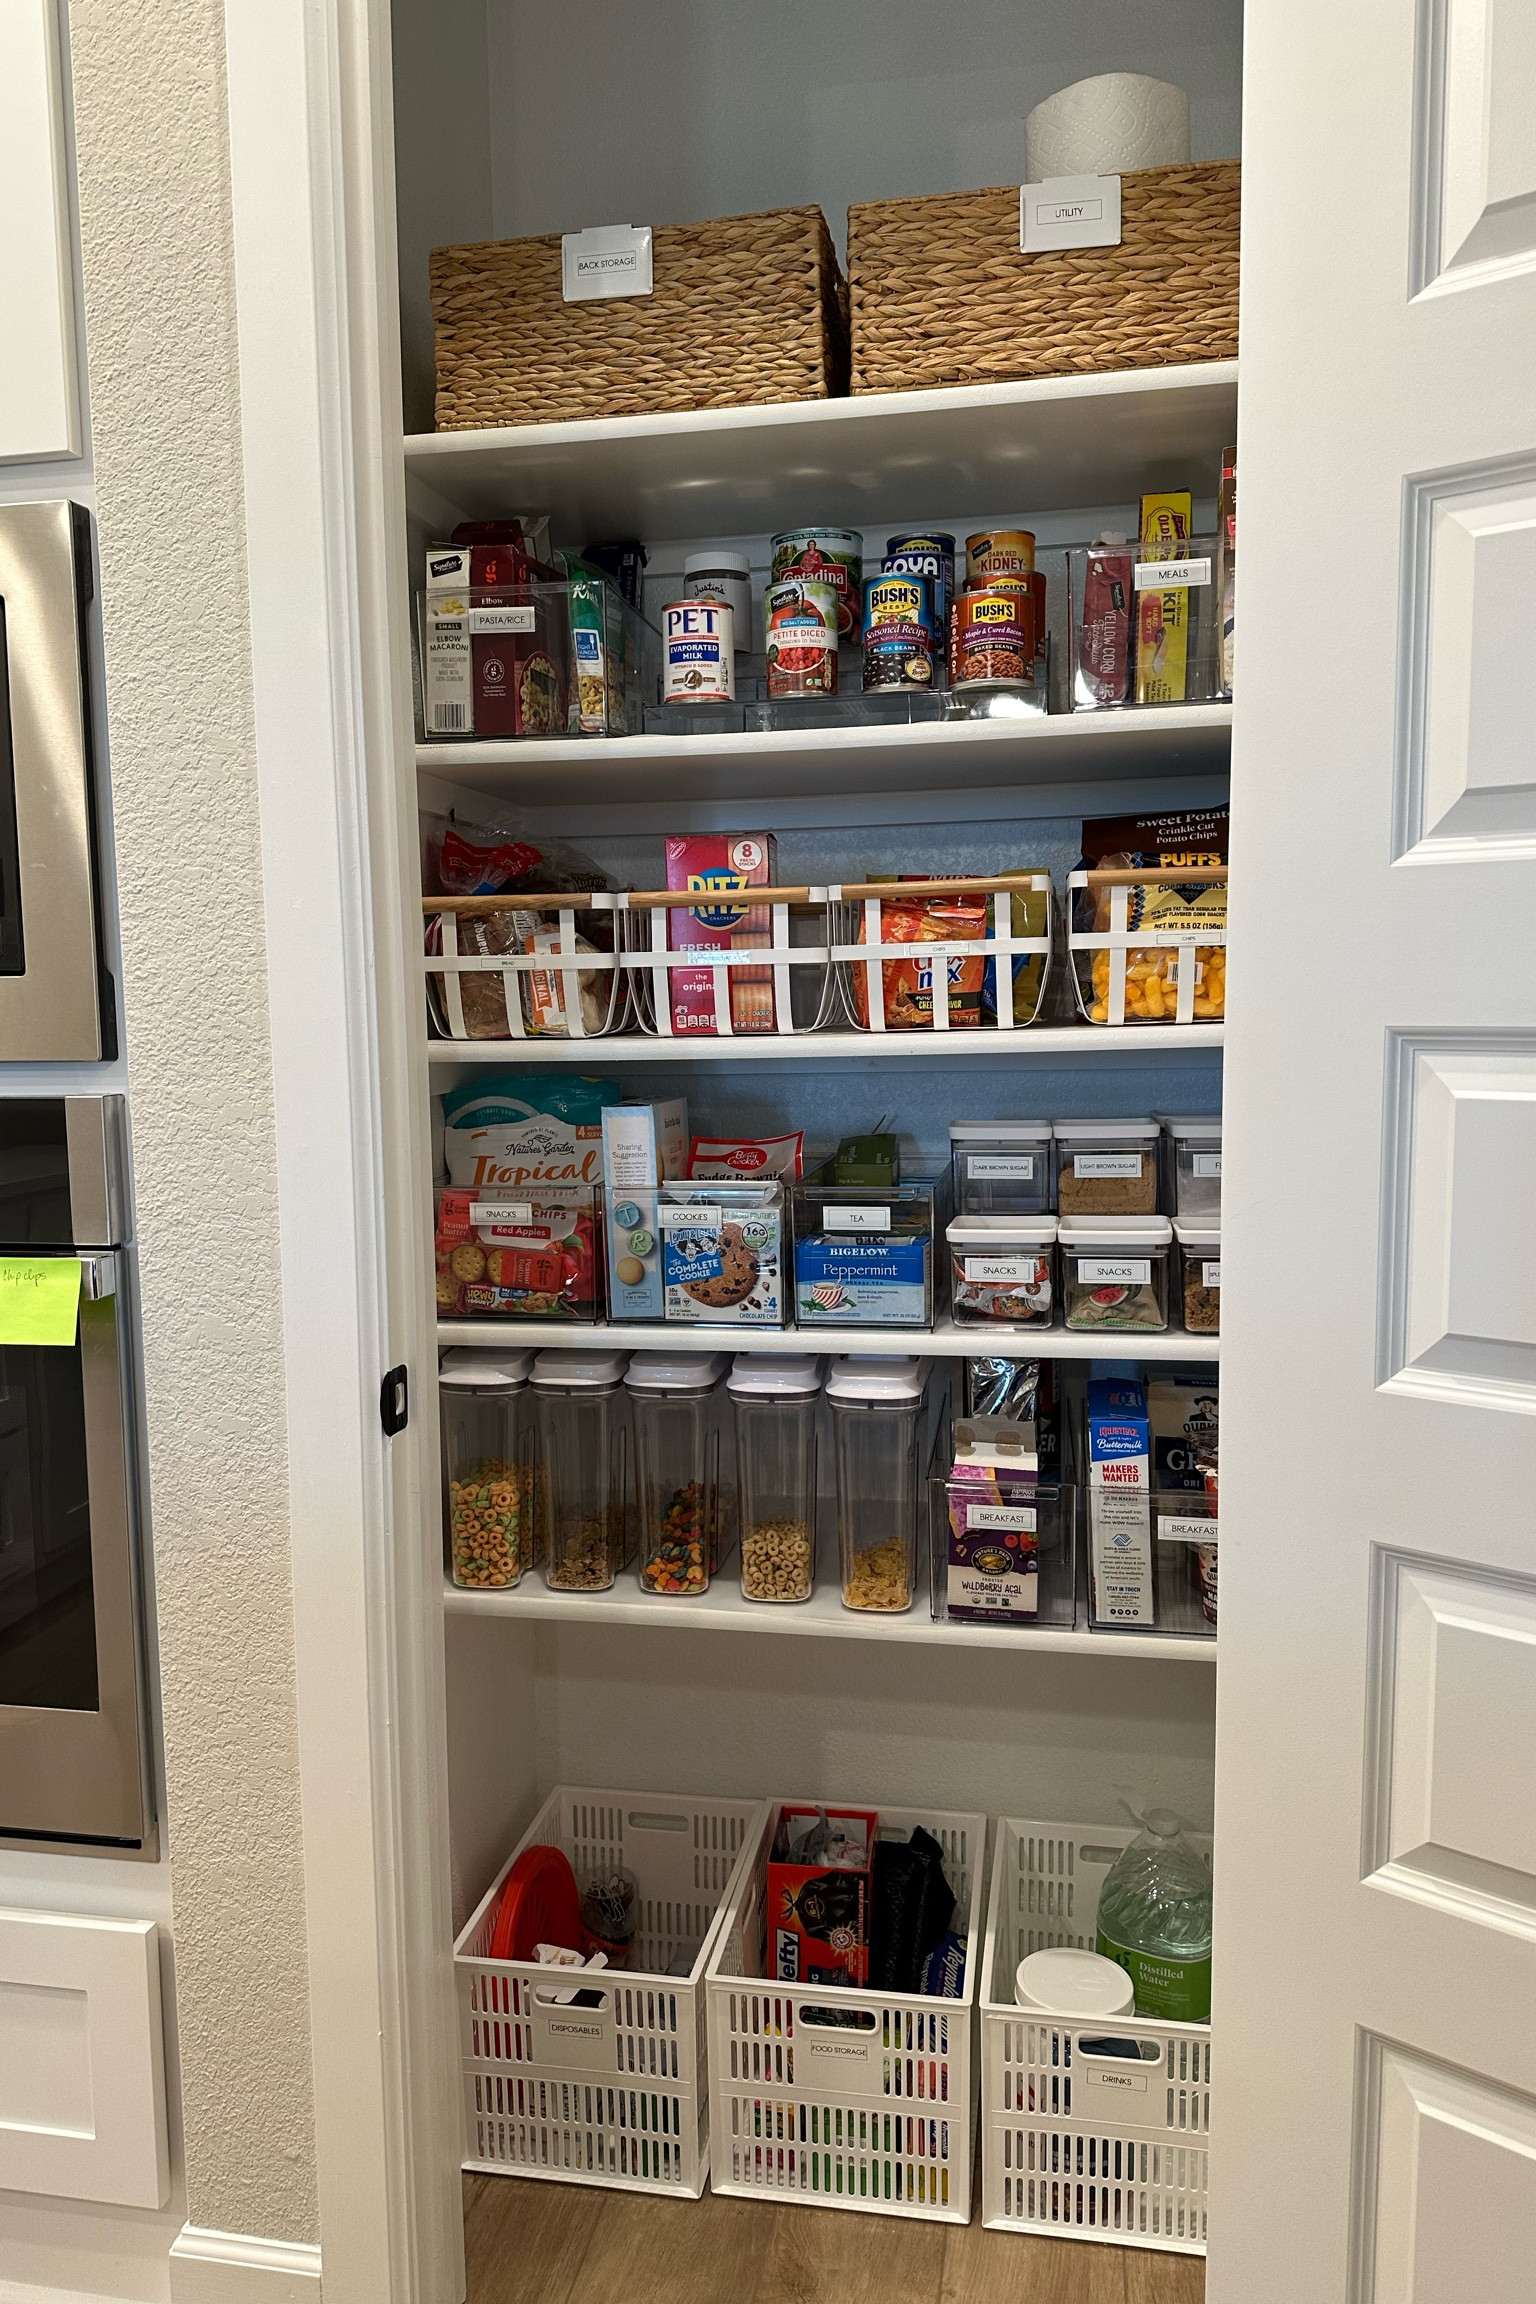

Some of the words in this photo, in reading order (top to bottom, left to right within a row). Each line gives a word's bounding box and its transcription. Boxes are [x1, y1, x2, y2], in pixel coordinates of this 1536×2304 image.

[1055, 207, 1084, 218] UTILITY
[579, 261, 600, 270] BACK
[600, 257, 635, 268] STORAGE
[884, 557, 938, 576] GOYA
[981, 558, 1024, 572] KIDNEY
[1158, 569, 1189, 579] MEALS
[695, 582, 726, 596] Justin's
[481, 597, 504, 605] Elbow
[871, 587, 919, 609] BUSH'S
[975, 603, 1013, 620] BUSH'S
[1162, 592, 1177, 627] KIT
[479, 616, 526, 626] PASTA/RICE
[668, 608, 718, 637] PET
[1151, 607, 1159, 628] HARD
[866, 624, 900, 641] Seasoned
[901, 624, 927, 637] Recipe
[964, 628, 982, 640] Maple
[1006, 627, 1023, 637] Bacon
[1103, 610, 1117, 646] YELLOW
[436, 635, 462, 643] ELBOW
[773, 630, 799, 640] PETITE
[801, 629, 826, 638] DICED
[429, 643, 469, 652] MACARONI
[670, 644, 718, 654] EVAPORATED
[873, 646, 893, 654] BLACK
[974, 644, 993, 652] BAKED
[994, 643, 1014, 651] BEANS
[682, 651, 703, 660] MILK
[1100, 647, 1116, 675] CORN
[1103, 682, 1115, 698] 12
[1158, 825, 1196, 836] Crinkle
[1197, 822, 1216, 830] Cut
[1156, 835, 1188, 844] Potato
[1189, 830, 1218, 841] Chips
[741, 843, 753, 858] 8
[1160, 852, 1222, 868] PUFFS
[687, 875, 750, 918] RITZ
[680, 943, 721, 952] FRESH
[919, 967, 963, 991] mx
[533, 969, 550, 1001] IGINAL
[682, 981, 715, 993] origin
[577, 1129, 586, 1138] 4
[543, 1142, 576, 1157] Garden
[616, 1143, 643, 1152] Sharing
[612, 1151, 648, 1160] Suggestion
[734, 1150, 760, 1160] Betty
[727, 1157, 762, 1166] Crocker
[1116, 1161, 1137, 1169] SUGAR
[470, 1149, 601, 1186] Tropical
[486, 1210, 517, 1219] SNACKS
[532, 1209, 567, 1220] CHIPS
[672, 1212, 708, 1221] COOKIES
[849, 1214, 865, 1222] TEA
[443, 1220, 469, 1230] Peanut
[496, 1225, 516, 1235] Red
[518, 1226, 546, 1238] Apples
[632, 1232, 646, 1252] R
[829, 1247, 889, 1256] BIGELOW
[668, 1259, 720, 1276] COMPLETE
[823, 1263, 898, 1282] Peppermint
[982, 1266, 1017, 1275] SNACKS
[1097, 1267, 1132, 1276] SNACKS
[679, 1270, 712, 1281] COOKIE
[768, 1296, 778, 1309] 4
[1097, 1438, 1143, 1450] Buttermilk
[1102, 1464, 1139, 1474] MAKERS
[1102, 1474, 1140, 1483] WANTED
[979, 1513, 1025, 1523] BREAKFAST
[1171, 1524, 1218, 1535] BREAKFAST
[974, 1548, 998, 1559] NATURE'S
[779, 1932, 799, 1981] efty
[1139, 1961, 1184, 1979] Distilled
[1139, 1971, 1170, 1987] Water
[551, 2024, 600, 2035] DISPOSABLES
[811, 2045, 833, 2053] FOOD
[834, 2047, 867, 2056] STORAGE
[1102, 2074, 1132, 2086] DRINKS
